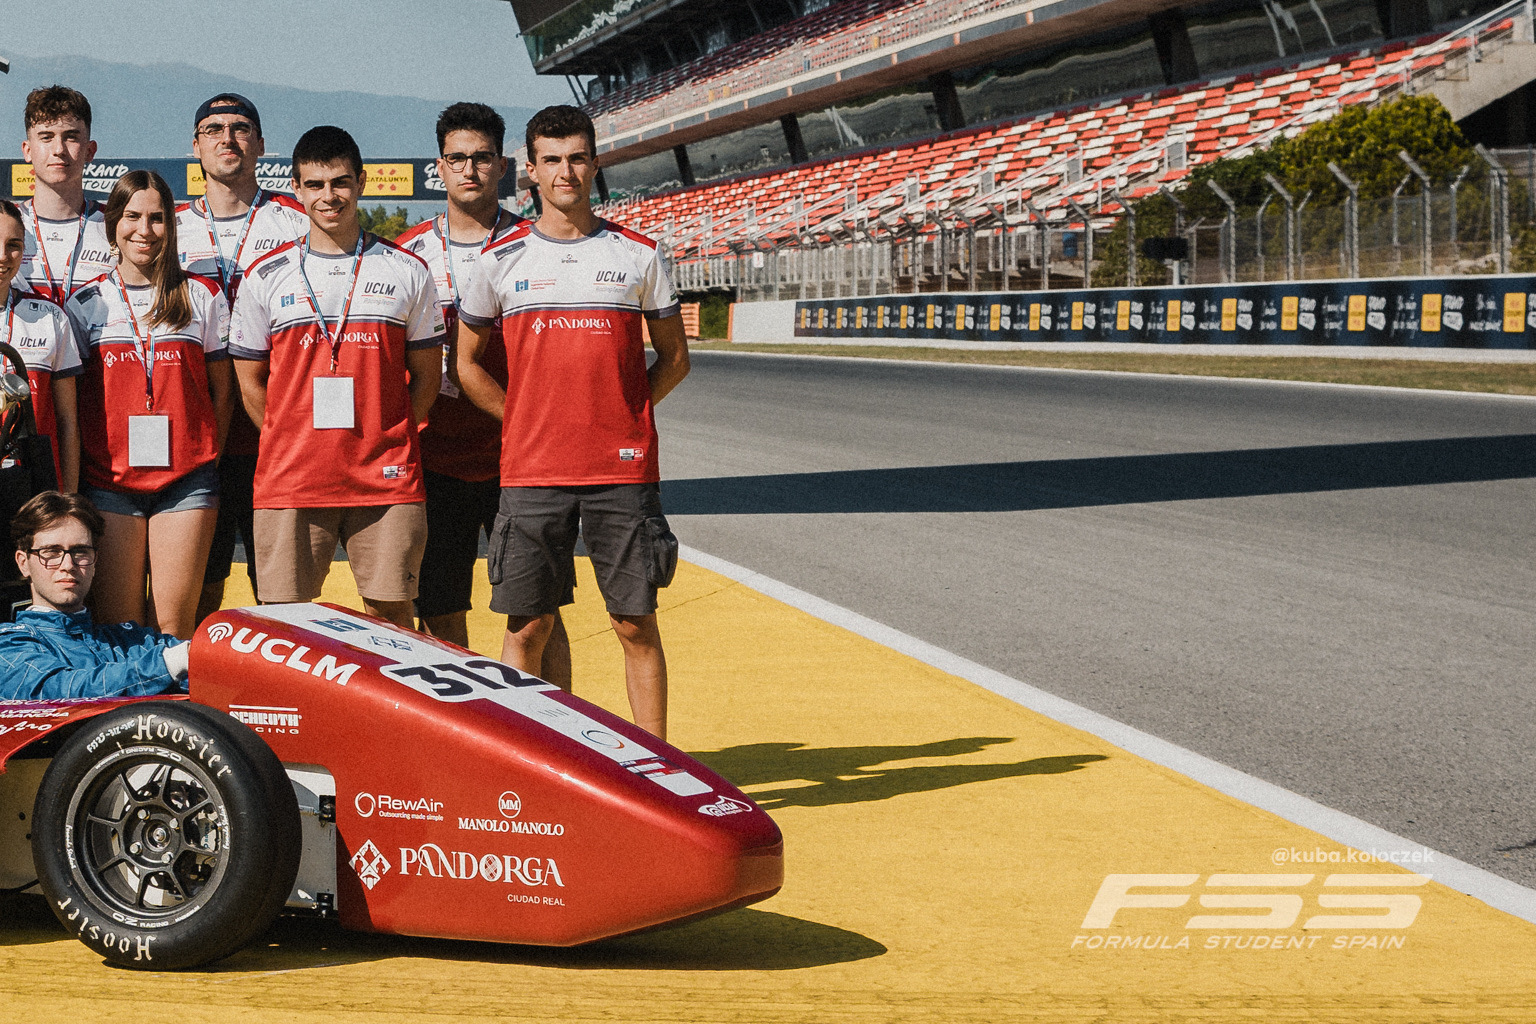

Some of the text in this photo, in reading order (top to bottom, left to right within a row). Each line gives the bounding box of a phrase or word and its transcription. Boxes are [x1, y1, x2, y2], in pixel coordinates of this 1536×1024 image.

[82, 163, 130, 177] RAND
[255, 163, 293, 177] GRAN
[83, 180, 115, 190] TOU
[80, 249, 111, 265] UCLM
[595, 270, 628, 284] UCLM
[364, 281, 397, 296] UCLM
[548, 316, 612, 329] PANDORGA
[19, 337, 48, 348] UCLM
[230, 626, 362, 687] UCLM
[389, 660, 550, 697] 312
[255, 727, 300, 735] CING
[131, 713, 233, 779] Hoosier
[378, 794, 444, 813] RewAir
[500, 799, 519, 811] MM
[378, 811, 411, 820] Outsourcing
[426, 813, 444, 822] simple
[458, 817, 565, 837] MANOLO MANOLO
[398, 842, 566, 887] PANDORGA
[507, 893, 566, 907] CIUDAD REAL
[57, 897, 157, 961] Hoosier
